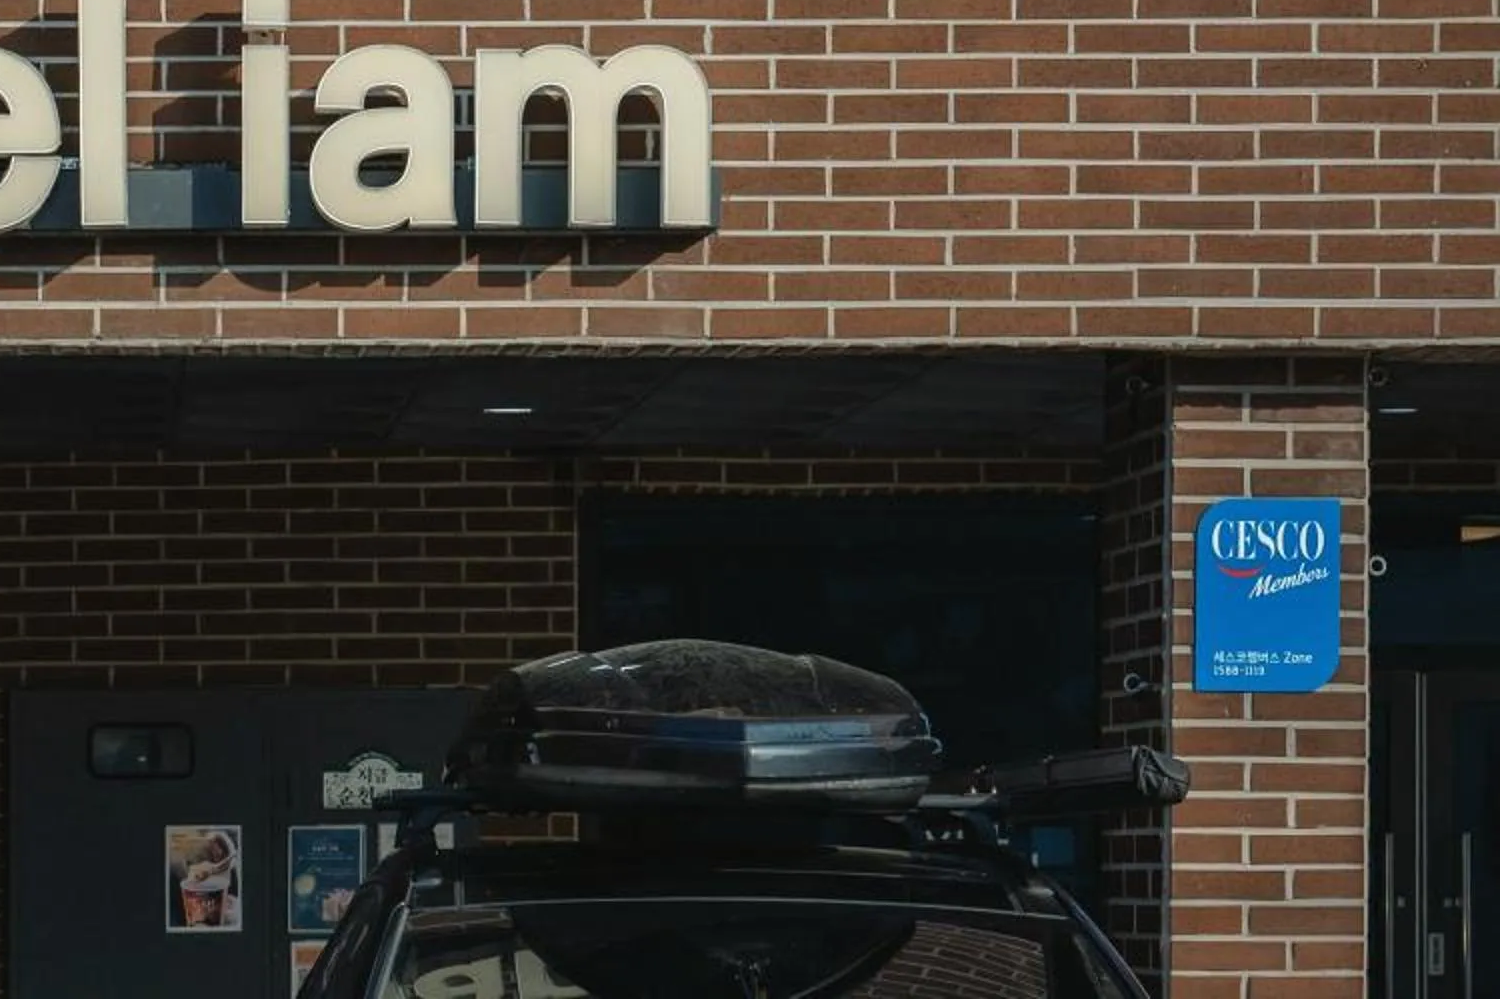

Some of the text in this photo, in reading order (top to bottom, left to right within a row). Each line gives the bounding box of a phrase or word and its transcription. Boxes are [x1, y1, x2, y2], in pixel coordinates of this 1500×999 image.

[1211, 520, 1325, 561] CESCO
[1248, 562, 1329, 599] Members
[1283, 651, 1313, 664] Zone
